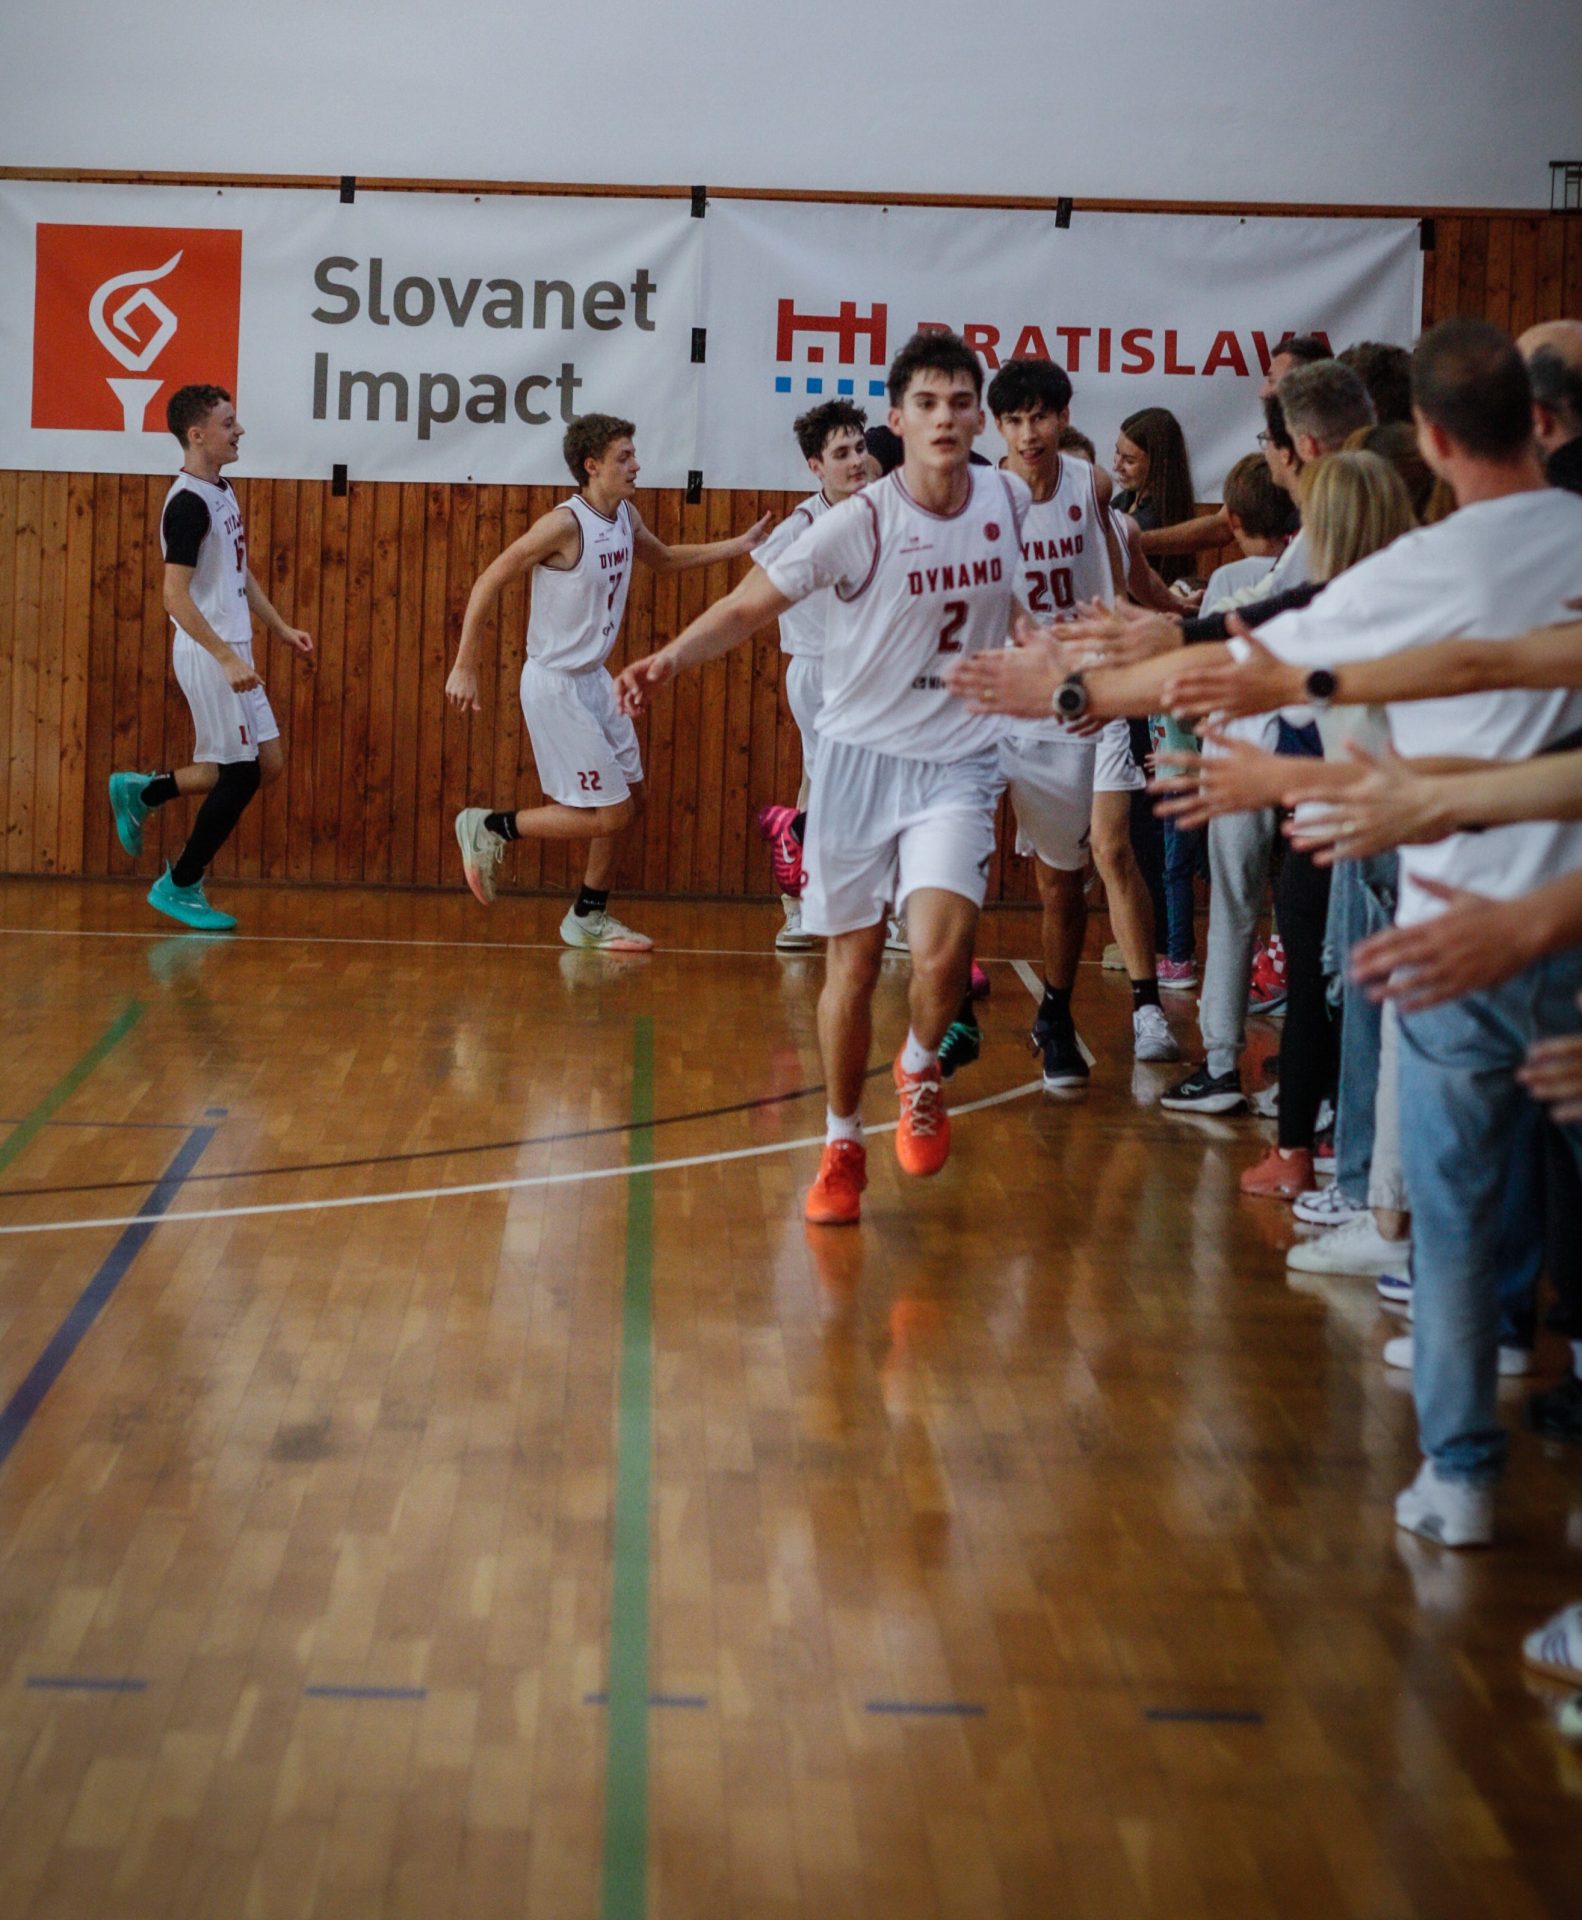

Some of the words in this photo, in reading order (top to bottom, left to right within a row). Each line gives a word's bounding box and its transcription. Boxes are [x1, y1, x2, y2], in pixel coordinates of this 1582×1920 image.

[311, 256, 657, 332] Slovanet
[917, 321, 1334, 377] RATISLAV
[313, 352, 582, 440] Impact
[1019, 533, 1084, 562] YNAMO
[908, 557, 1002, 595] DYNAMO
[1025, 567, 1076, 613] 20
[938, 600, 969, 653] 2
[577, 770, 602, 791] 22
